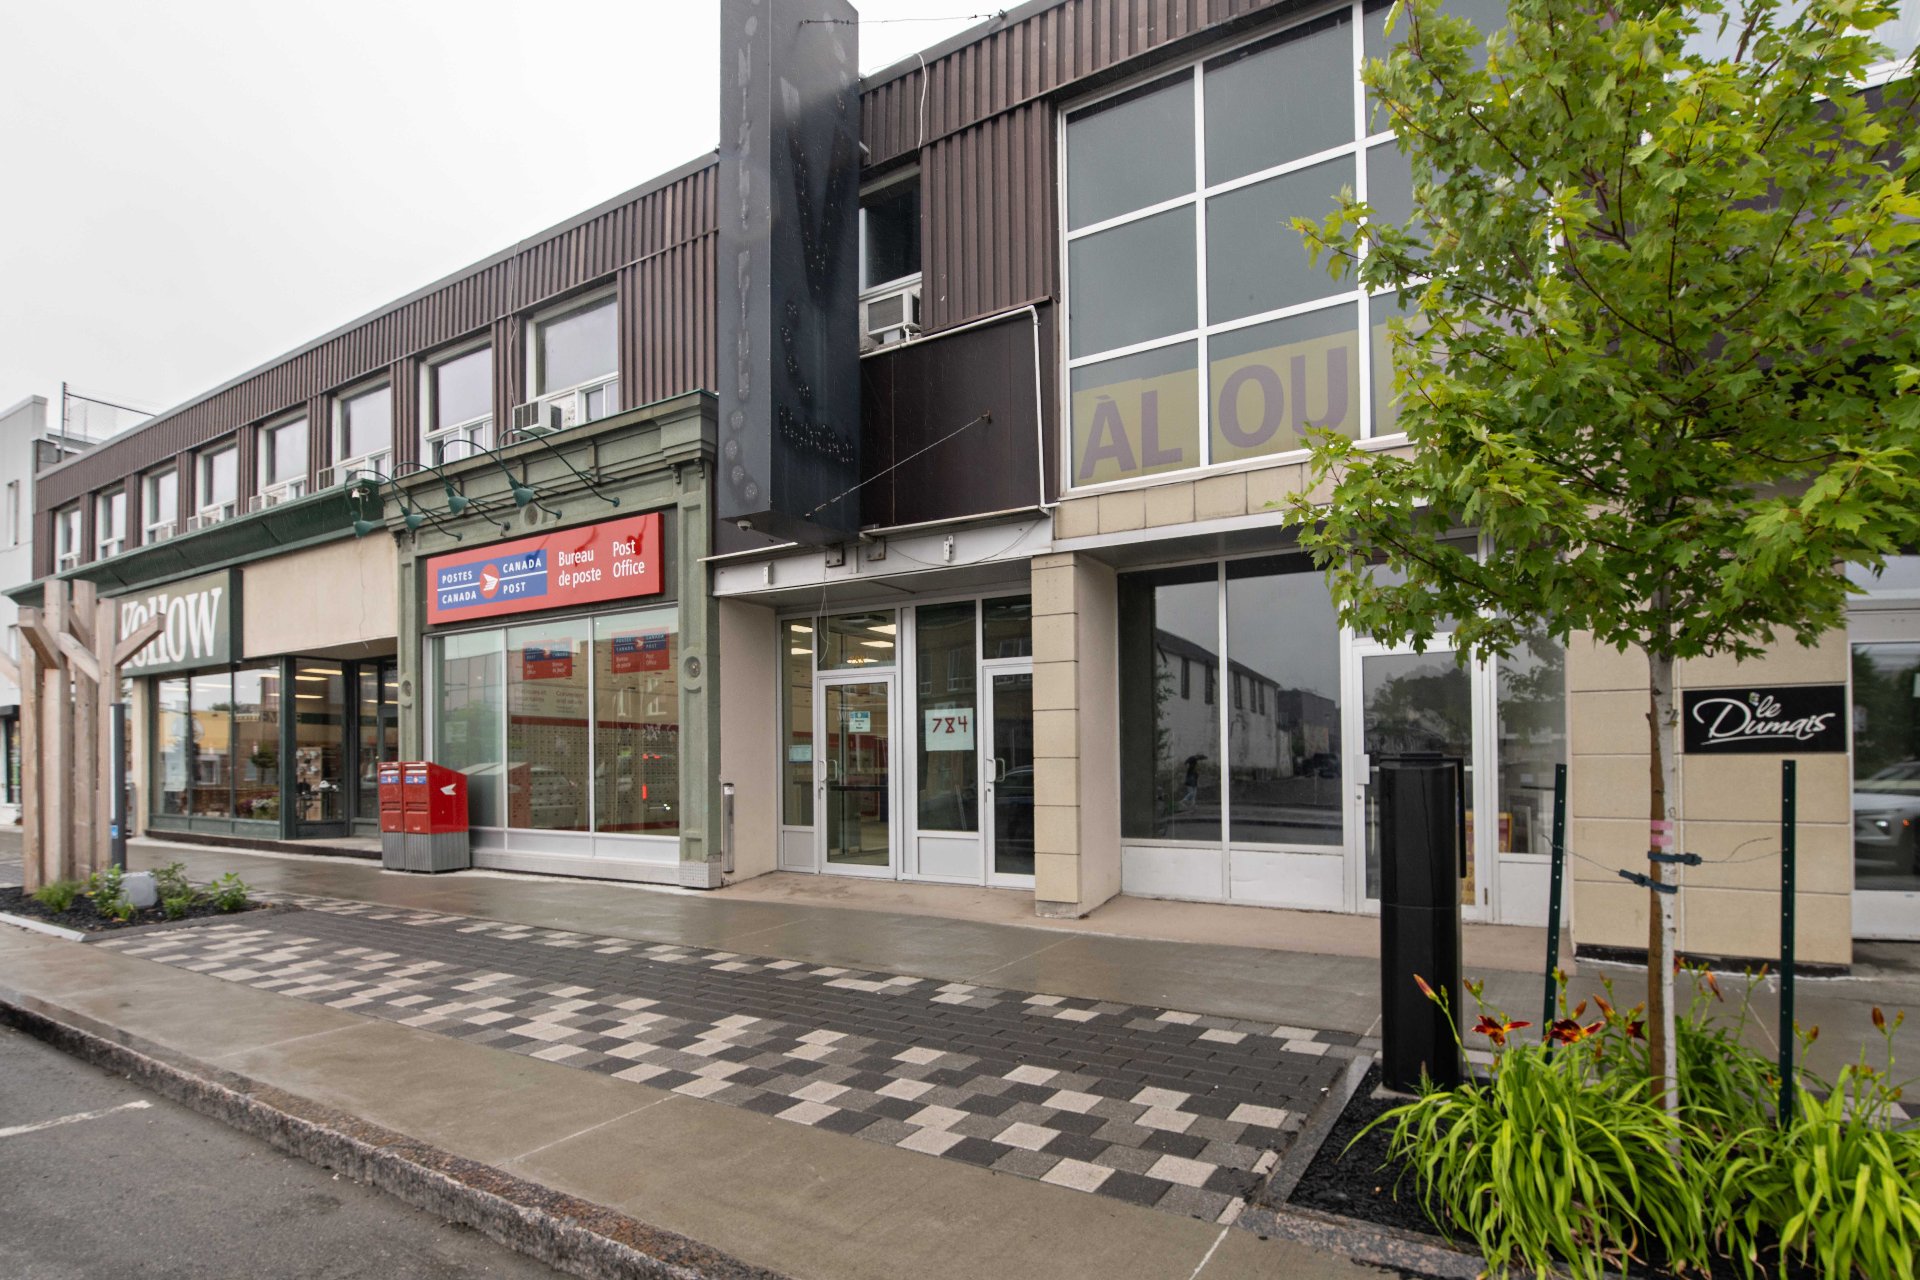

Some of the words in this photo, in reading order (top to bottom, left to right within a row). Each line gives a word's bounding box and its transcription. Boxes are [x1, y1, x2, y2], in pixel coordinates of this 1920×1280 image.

[613, 539, 636, 557] Post
[503, 557, 542, 573] CANADA
[558, 549, 594, 567] Bureau
[442, 570, 473, 584] POSTES
[558, 570, 571, 587] de
[572, 567, 602, 588] poste
[613, 559, 645, 578] Office
[503, 582, 526, 594] POST
[442, 591, 477, 604] CANADA
[932, 715, 968, 734] 784
[1692, 697, 1836, 741] Dumais
